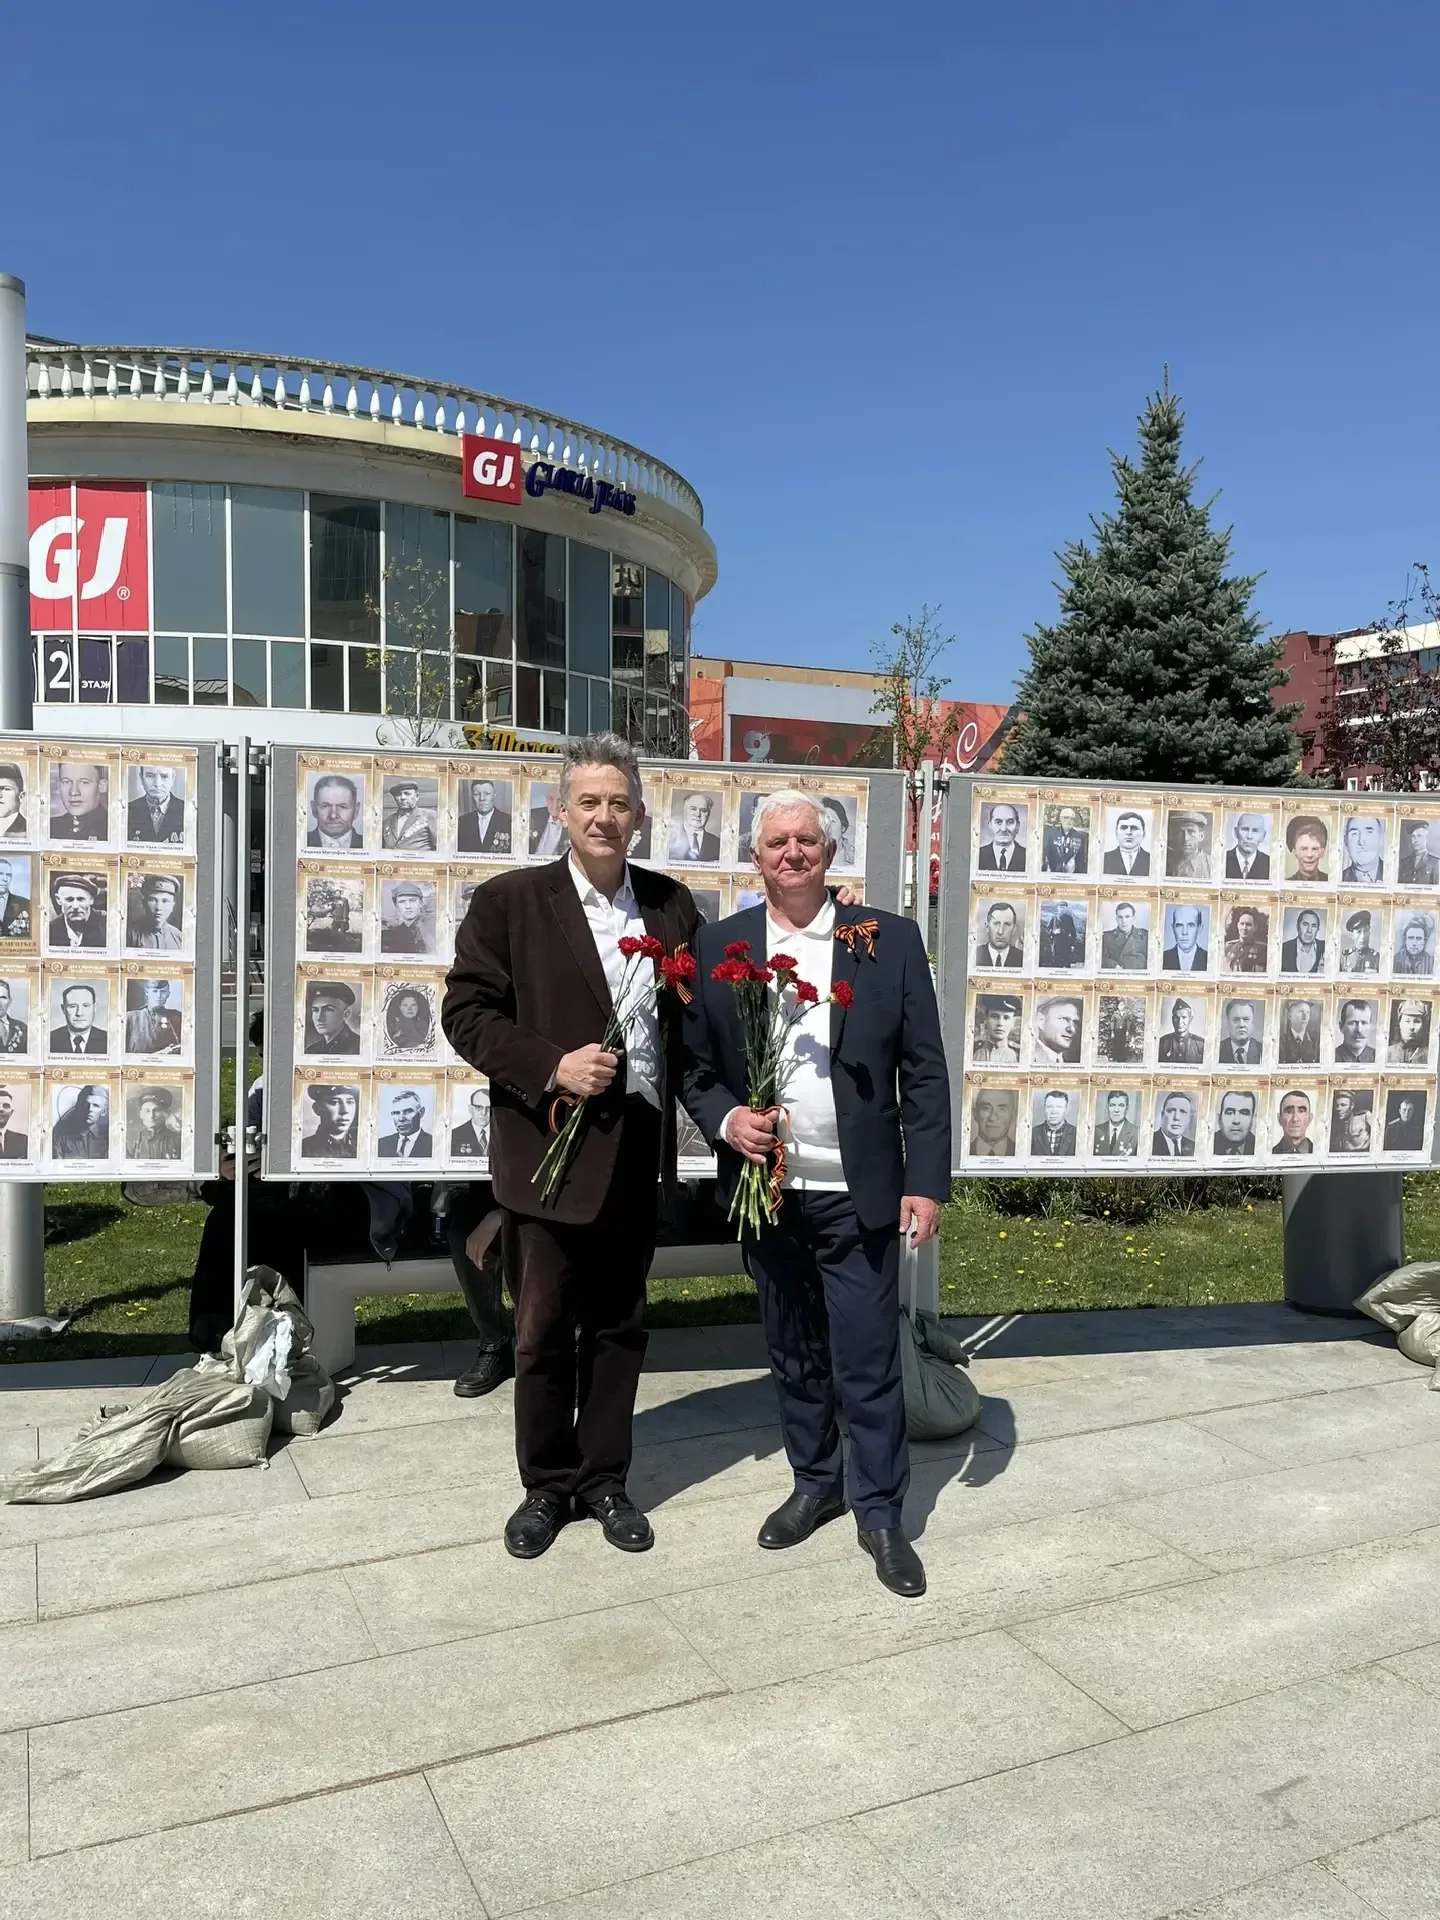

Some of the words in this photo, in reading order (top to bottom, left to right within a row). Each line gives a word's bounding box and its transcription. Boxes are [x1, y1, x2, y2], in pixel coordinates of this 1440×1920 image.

[472, 451, 514, 487] GJ
[29, 515, 129, 600] GJ
[49, 650, 71, 689] 2
